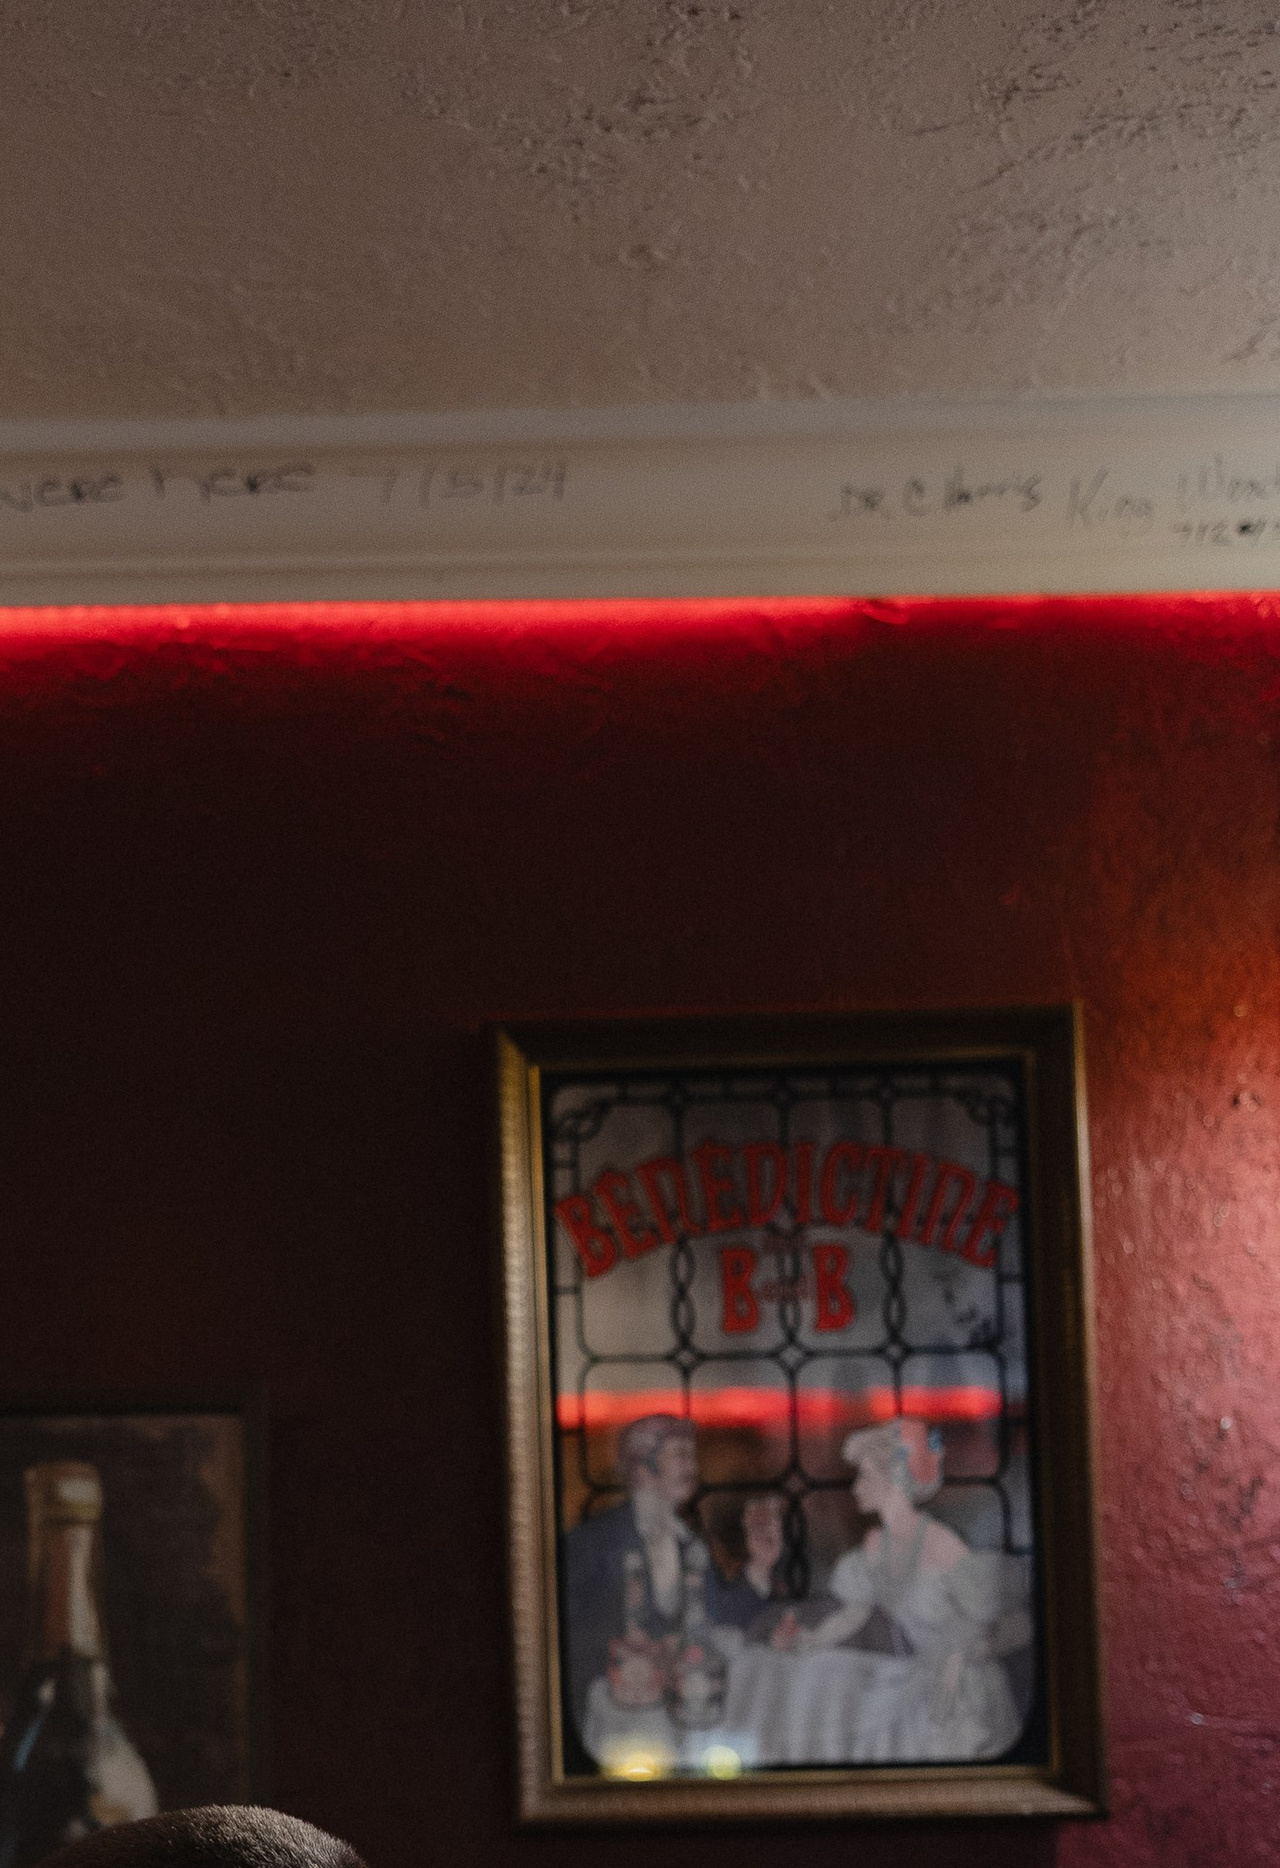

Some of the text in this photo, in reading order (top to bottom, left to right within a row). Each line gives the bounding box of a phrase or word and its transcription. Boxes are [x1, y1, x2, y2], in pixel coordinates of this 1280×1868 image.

[554, 1139, 1019, 1280] BENEDICTINE
[722, 1243, 855, 1334] B B
